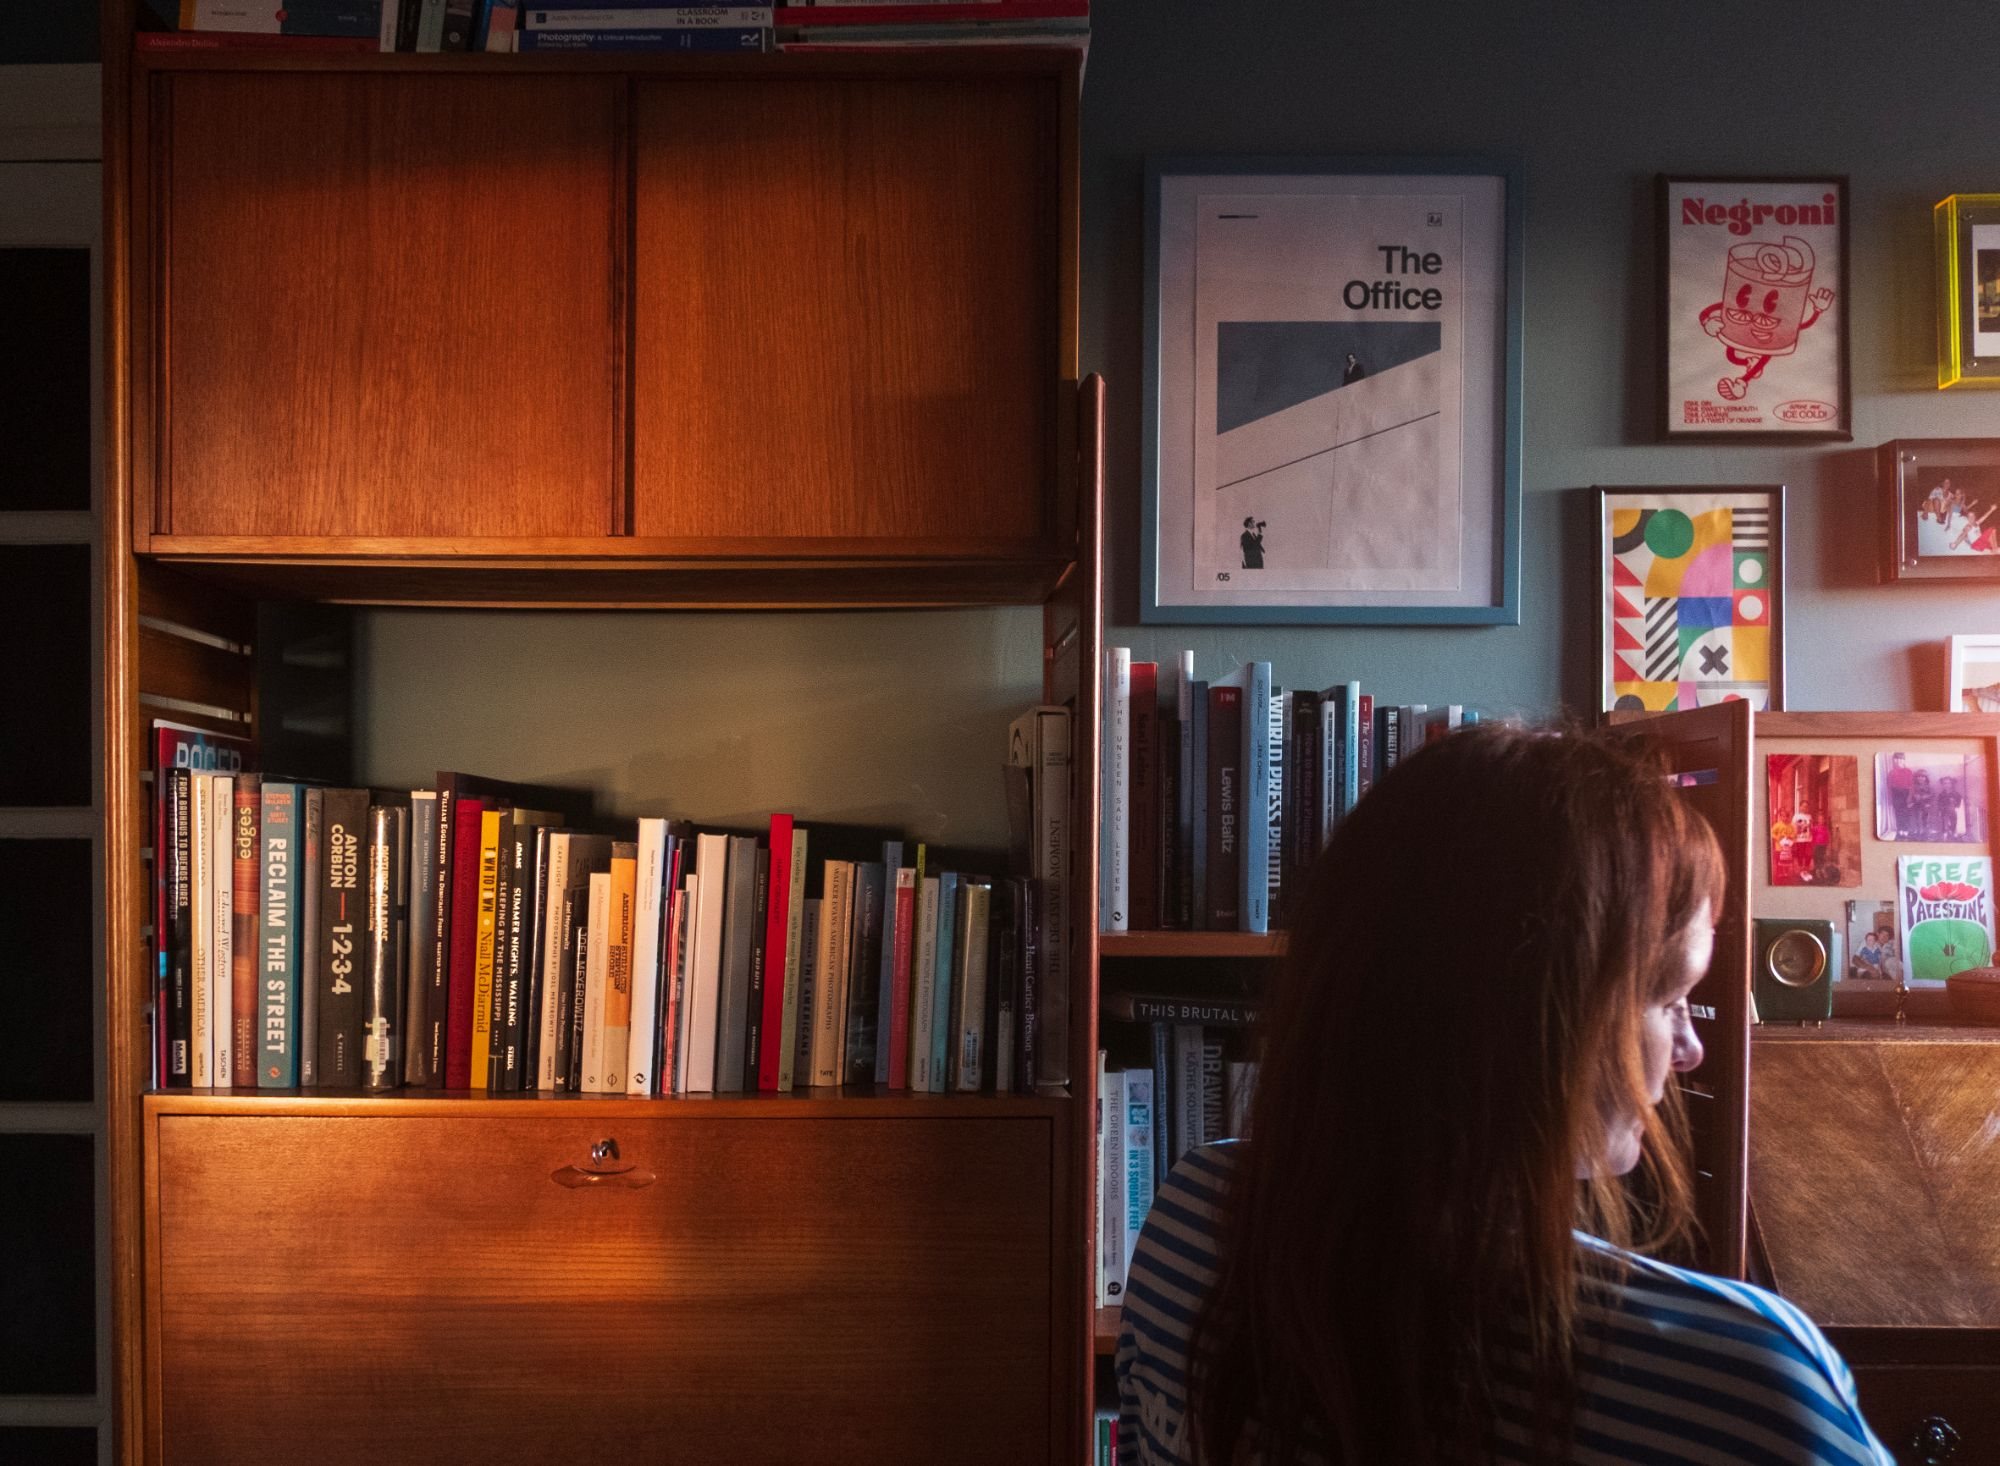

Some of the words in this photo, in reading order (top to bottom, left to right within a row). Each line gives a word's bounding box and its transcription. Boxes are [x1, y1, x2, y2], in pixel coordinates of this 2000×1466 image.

[677, 9, 728, 17] CLASSROOM
[1682, 193, 1835, 236] Negroni
[1378, 246, 1442, 274] The
[1344, 281, 1442, 310] Office
[1783, 410, 1798, 418] ICE
[1269, 695, 1283, 762] WORLD
[1362, 721, 1370, 735] The
[1387, 711, 1397, 725] THE
[1362, 739, 1370, 768] Camera
[1387, 726, 1397, 752] STREET
[179, 777, 188, 798] FROM
[1221, 767, 1235, 813] Lewis
[1269, 766, 1282, 822] PRESS
[179, 800, 188, 836] BAUHAUS
[441, 791, 449, 822] WILLIAM
[179, 839, 188, 848] TO
[237, 808, 256, 859] edges
[440, 824, 448, 864] EGGLESTON
[1049, 816, 1061, 878] MOMENT
[1221, 815, 1235, 854] Baltz
[179, 851, 188, 881] BUENOS
[330, 824, 343, 887] CORBIJN
[345, 834, 357, 888] ANTON
[1268, 826, 1281, 888] PHOTO
[268, 838, 287, 927] RECLAIM
[484, 875, 495, 884] TO
[832, 867, 840, 899] WALKER
[1907, 862, 1983, 887] FREE
[179, 884, 188, 906] AIRES
[498, 882, 507, 927] SLEEPING
[511, 888, 521, 932] SUMMER
[1049, 882, 1060, 943] DECISIVE
[1906, 887, 1987, 930] PALESTINE
[479, 931, 492, 959] Niall
[498, 930, 504, 942] BY
[563, 915, 571, 950] Meyerowitz
[579, 932, 587, 957] JOEL
[828, 929, 837, 970] AMERICAN
[197, 948, 205, 983] OTHER
[268, 935, 285, 972] THE
[332, 923, 352, 994] 1-2-3-4
[551, 961, 557, 970] BY
[620, 945, 628, 994] SURFACES
[1025, 945, 1035, 974] Henri
[1049, 950, 1060, 976] THE
[804, 963, 813, 984] THE
[476, 963, 491, 1033] McDiarmid
[494, 967, 503, 1021] MISSISSIPPI
[508, 981, 517, 1026] WALKING
[574, 961, 586, 1032] MEYEROWITZ
[825, 972, 835, 1030] PHOTOGRAPHS
[921, 986, 930, 1033] PHOTOGRAPH
[1025, 975, 1035, 1010] Cartier
[197, 987, 205, 1037] AMERICAS
[267, 980, 285, 1054] STREET
[548, 991, 556, 1037] MEYEROWITZ
[800, 989, 812, 1057] AMERICANS
[1140, 1003, 1175, 1018] THIS
[1181, 1005, 1239, 1022] BRUTAL
[1024, 1013, 1035, 1052] Bresson
[175, 1042, 183, 1071] MoMA
[1186, 1052, 1200, 1091] KÄTHE
[1110, 1090, 1119, 1113] THE
[1203, 1045, 1223, 1139] DRAWING
[1110, 1115, 1119, 1150] GREEN
[1129, 1150, 1139, 1160] IN
[1109, 1153, 1119, 1201] INDOORS
[1129, 1171, 1139, 1208] SQUARE
[1129, 1210, 1139, 1231] FEET
